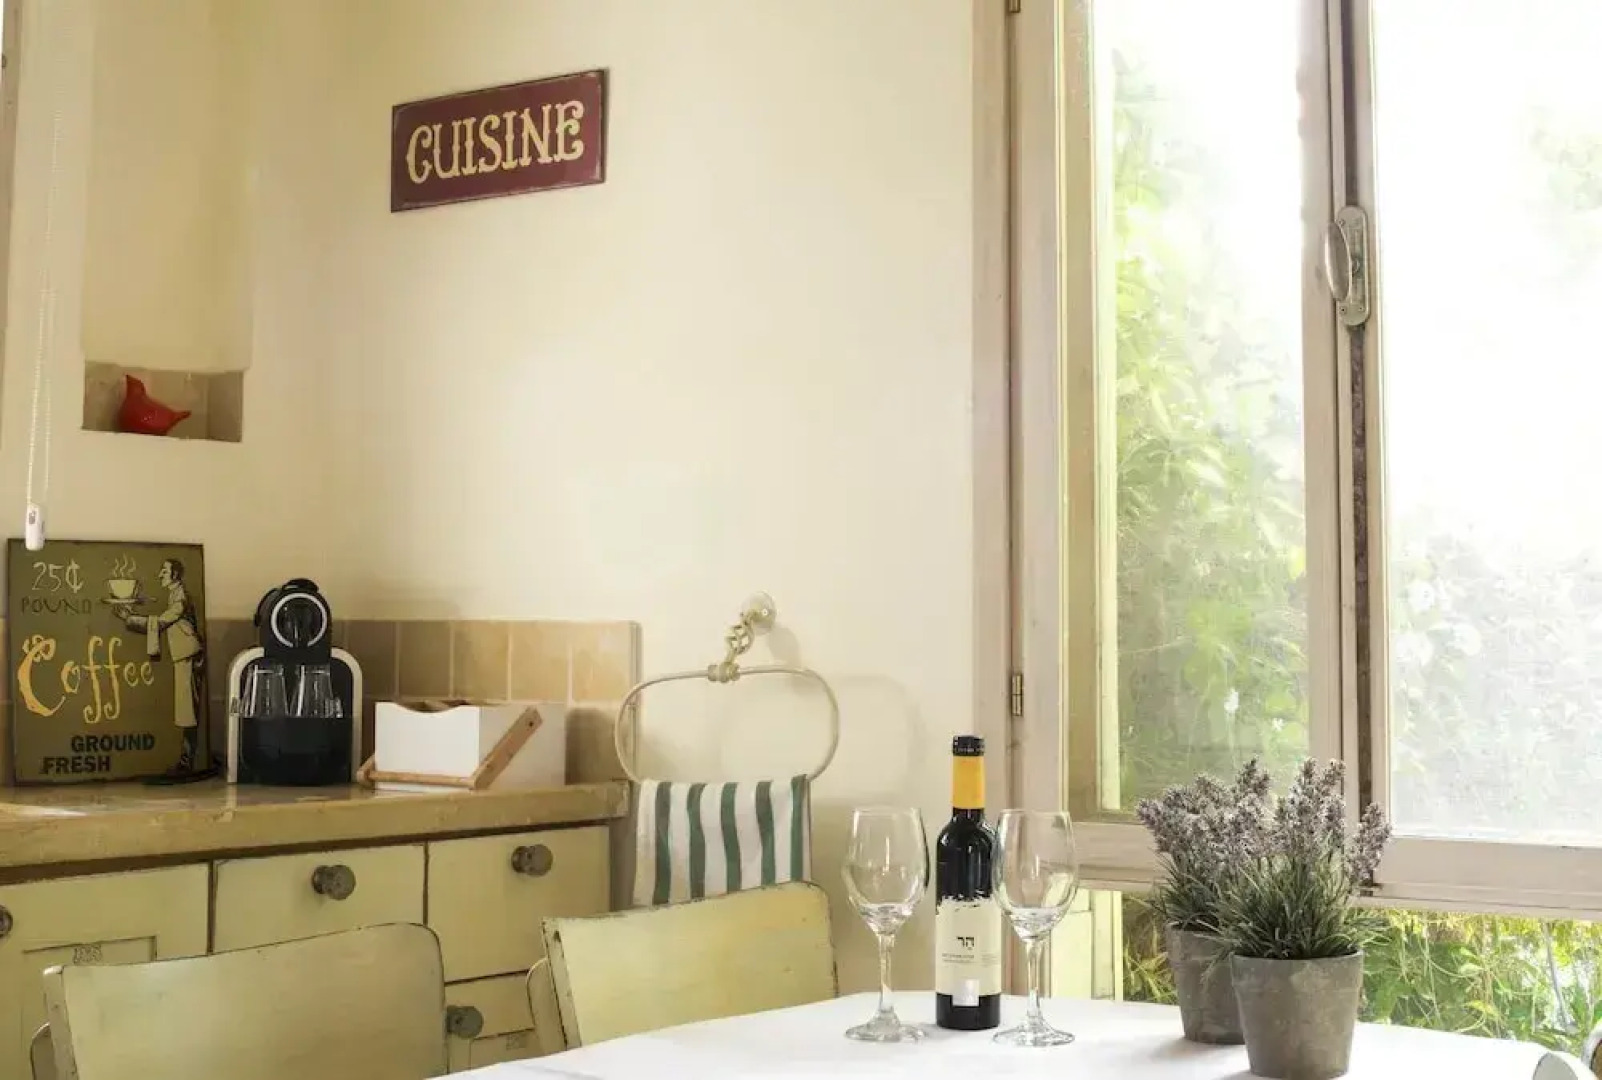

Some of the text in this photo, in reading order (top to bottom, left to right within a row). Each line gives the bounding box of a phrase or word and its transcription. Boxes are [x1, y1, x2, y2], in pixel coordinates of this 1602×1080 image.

[406, 100, 584, 184] CUISINE
[32, 558, 84, 594] 25¢
[21, 596, 92, 614] POUND
[17, 635, 155, 724] Coffee
[71, 733, 156, 754] GROUND
[40, 755, 111, 775] FRESH
